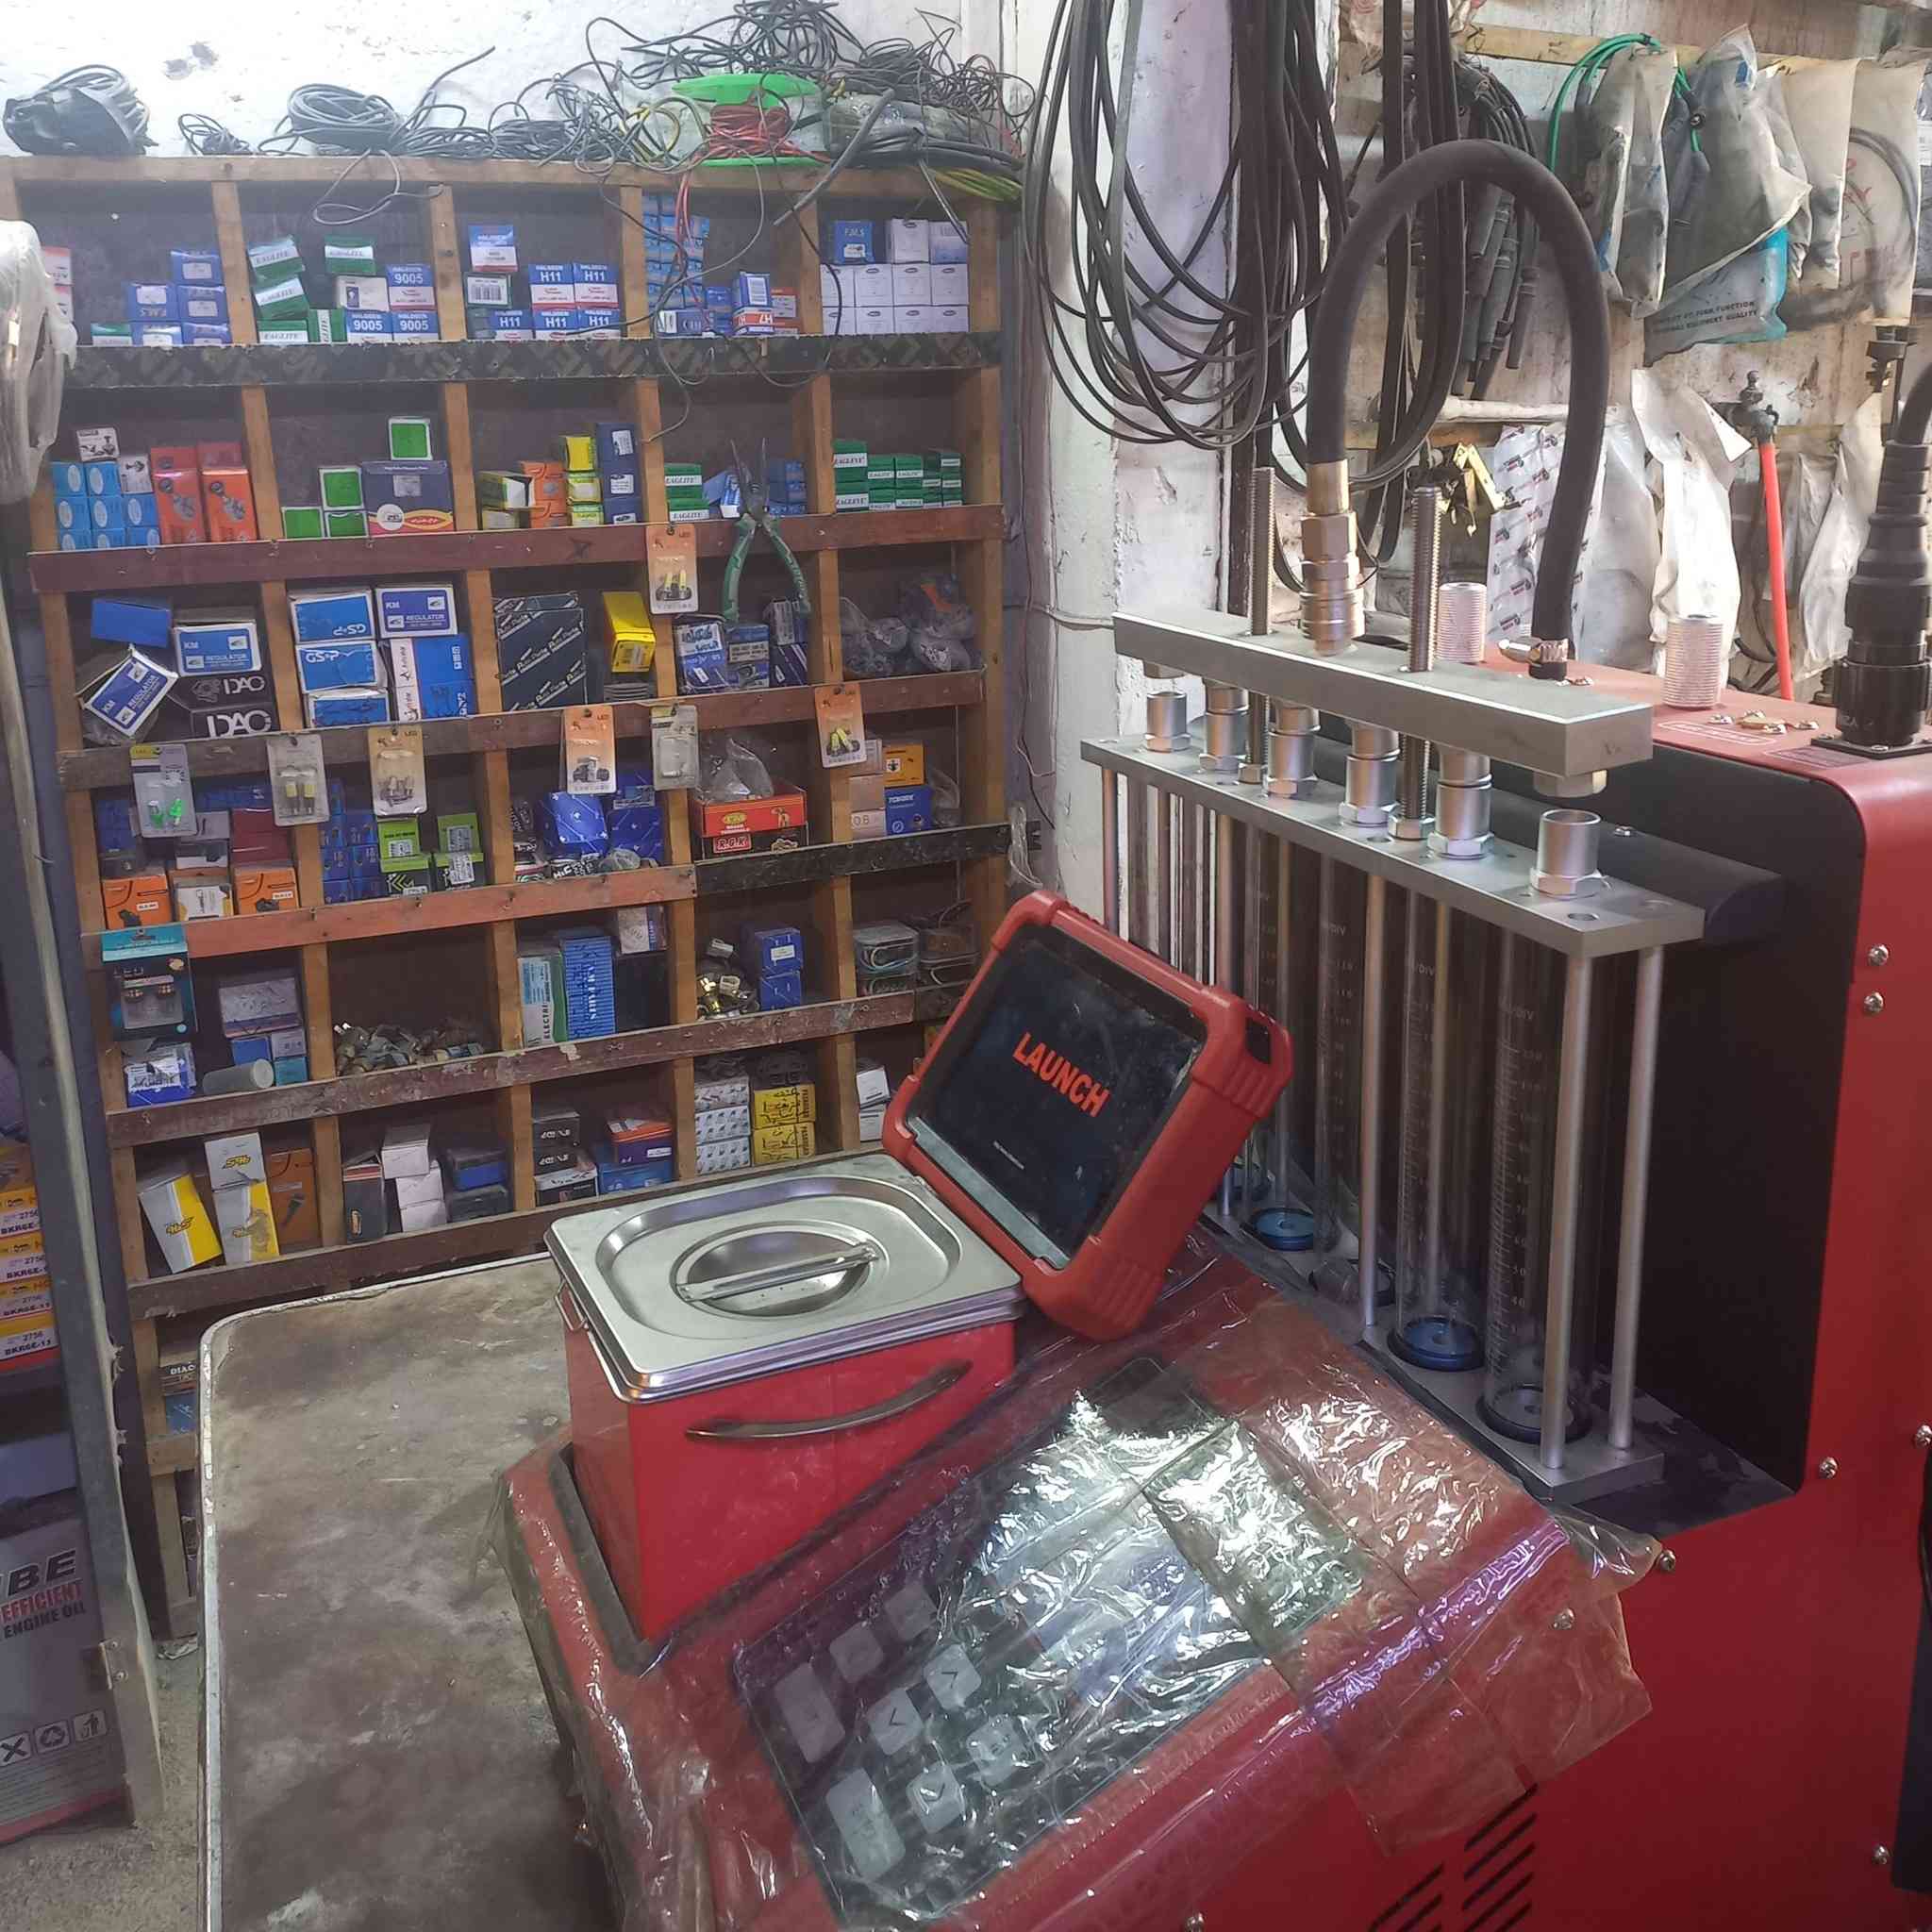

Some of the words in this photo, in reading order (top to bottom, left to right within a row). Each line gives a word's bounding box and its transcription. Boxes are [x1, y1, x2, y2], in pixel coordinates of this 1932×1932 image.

[394, 274, 424, 284] 9005
[541, 272, 561, 282] H11
[585, 271, 605, 281] H11
[354, 321, 383, 331] 9005
[400, 321, 429, 331] 9005
[500, 317, 521, 327] H11
[546, 317, 566, 327] H11
[589, 316, 609, 326] H11
[1012, 1032, 1110, 1118] LAUNCH
[1, 1221, 42, 1234] BKR6E-
[0, 1548, 77, 1598] BE
[1, 1581, 83, 1624] EFFICIENT
[4, 1609, 60, 1640] ENGINE
[62, 1601, 87, 1621] OIL
